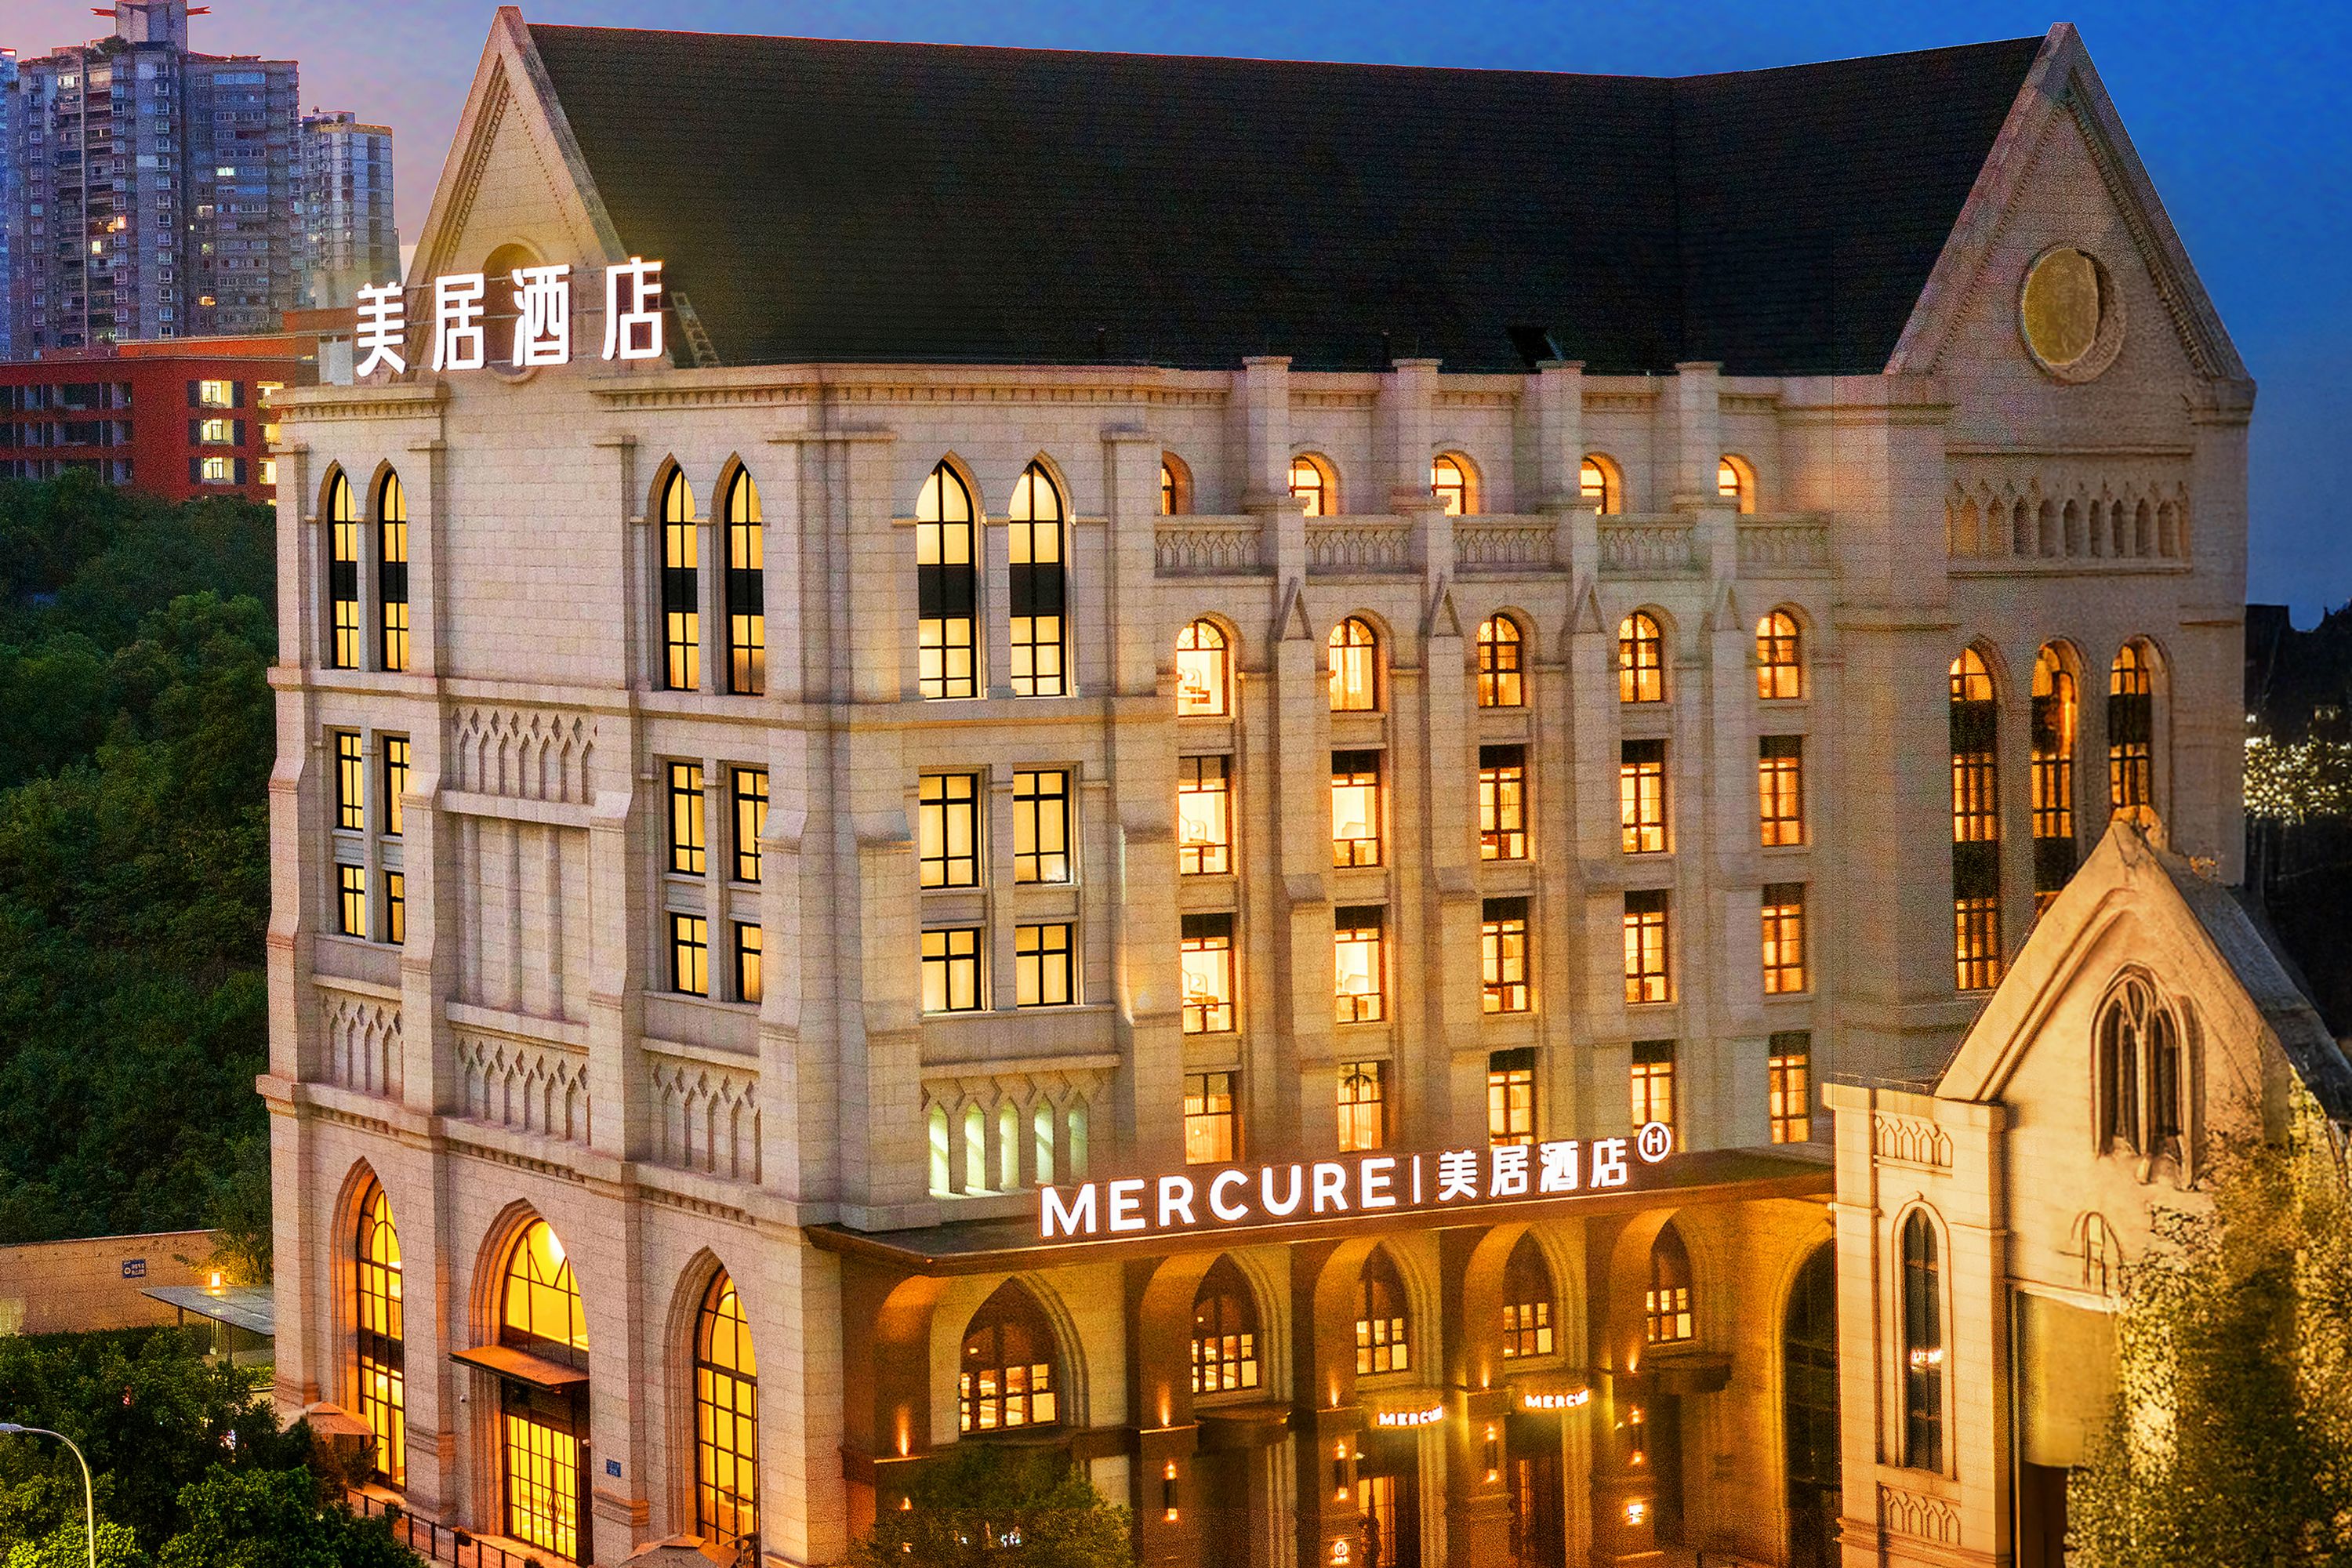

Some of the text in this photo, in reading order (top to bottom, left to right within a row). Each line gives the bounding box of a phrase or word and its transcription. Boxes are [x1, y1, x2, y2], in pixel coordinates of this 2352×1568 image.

[357, 257, 662, 376] 美居酒店
[1041, 1157, 1396, 1237] MERCURE
[1438, 1138, 1627, 1201] 美居酒店
